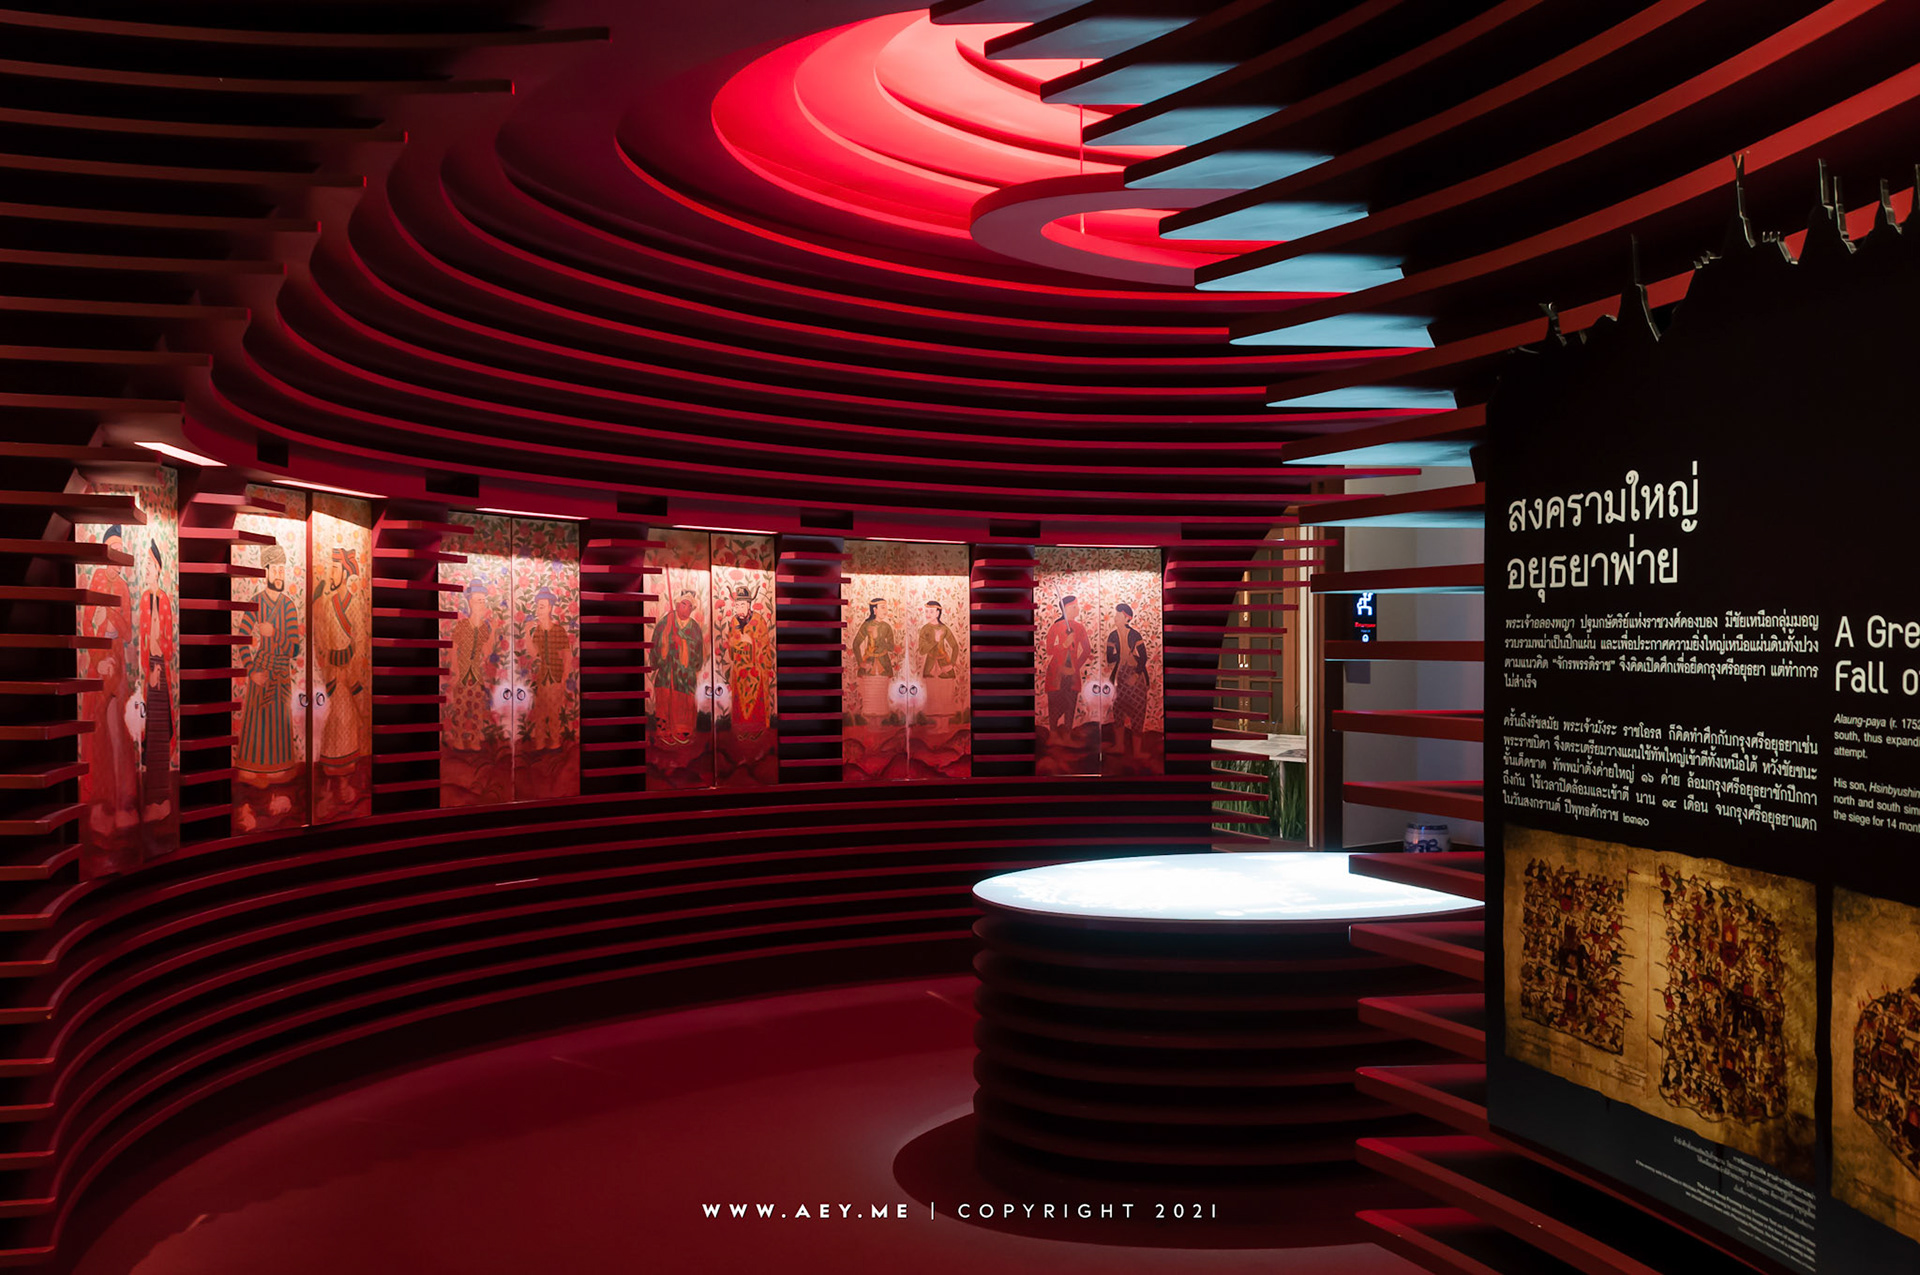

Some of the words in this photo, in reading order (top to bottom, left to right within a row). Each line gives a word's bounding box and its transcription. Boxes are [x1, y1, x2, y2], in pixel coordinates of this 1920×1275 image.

[1508, 460, 1699, 533] สงครามใหญ่
[1507, 533, 1679, 604] อยุธยาพ่าย
[1505, 613, 1576, 632] พระเจ้าอลองพญา
[1580, 611, 1718, 633] ปฐมกษัตริย์แห่งราชวงศ์คองบอง
[1724, 608, 1819, 634] มีชัยเหนือกลุ่มมอญ
[1834, 615, 1855, 648] A
[1504, 633, 1597, 649] รวบรวมพม่าเป็นปึกแผ่น
[1600, 628, 1819, 655] และเพื่อประกาศความยิ่งใหญ่เหนือแผ่นดินทั้งปวง
[1504, 654, 1549, 669] ตามแนวคิด
[1619, 652, 1766, 682] จึงคิดเปิดศึกเพื่อยึดกรุงศรีอยุธยา
[1770, 658, 1819, 678] แต่ทำการ
[1504, 672, 1537, 688] ไม่สำเร็จ
[1835, 660, 1889, 694] Fall
[1902, 668, 1920, 696] o
[1503, 707, 1559, 731] ครั้นถึงรัชสมัย
[1563, 717, 1617, 736] พระเจ้ามังระ
[1623, 722, 1662, 740] ราชโอรส
[1668, 724, 1819, 757] ก็คิดทำศึกกับกรุงศรีอยุธยาเช่น
[1834, 713, 1886, 729] Alaung-paya
[1834, 730, 1861, 743] south,
[1864, 732, 1883, 744] thus
[1503, 734, 1550, 750] พระราชบิดา
[1762, 758, 1818, 780] หวังชัยชนะ
[1834, 746, 1868, 760] attempt.
[1503, 746, 1547, 770] ขั้นเด็ดขาด
[1552, 755, 1635, 784] ทัพพม่าตั้งค่ายใหญ่
[1660, 768, 1680, 787] ค่าย
[1687, 771, 1818, 806] ล้อมกรุงศรีอยุธยาชักปีกกา
[1833, 777, 1847, 789] His
[1849, 780, 1867, 792] son,
[1502, 789, 1561, 812] ในวันสงกรานต์
[1564, 797, 1619, 822] ปีพุทธศักราช
[1503, 769, 1526, 787] ถึงกัน
[1530, 774, 1630, 801] ใช้เวลาปิดล้อมและเข้าตี
[1636, 792, 1656, 805] นาน
[1683, 794, 1708, 814] เดือน
[1715, 804, 1818, 831] จนกรุงศรีอยุธยาแตก
[1833, 795, 1855, 806] north
[1858, 798, 1874, 809] and
[1876, 801, 1901, 813] south
[1833, 809, 1847, 820] the
[1848, 813, 1871, 826] siege
[1872, 815, 1885, 827] for
[1887, 818, 1897, 829] 14
